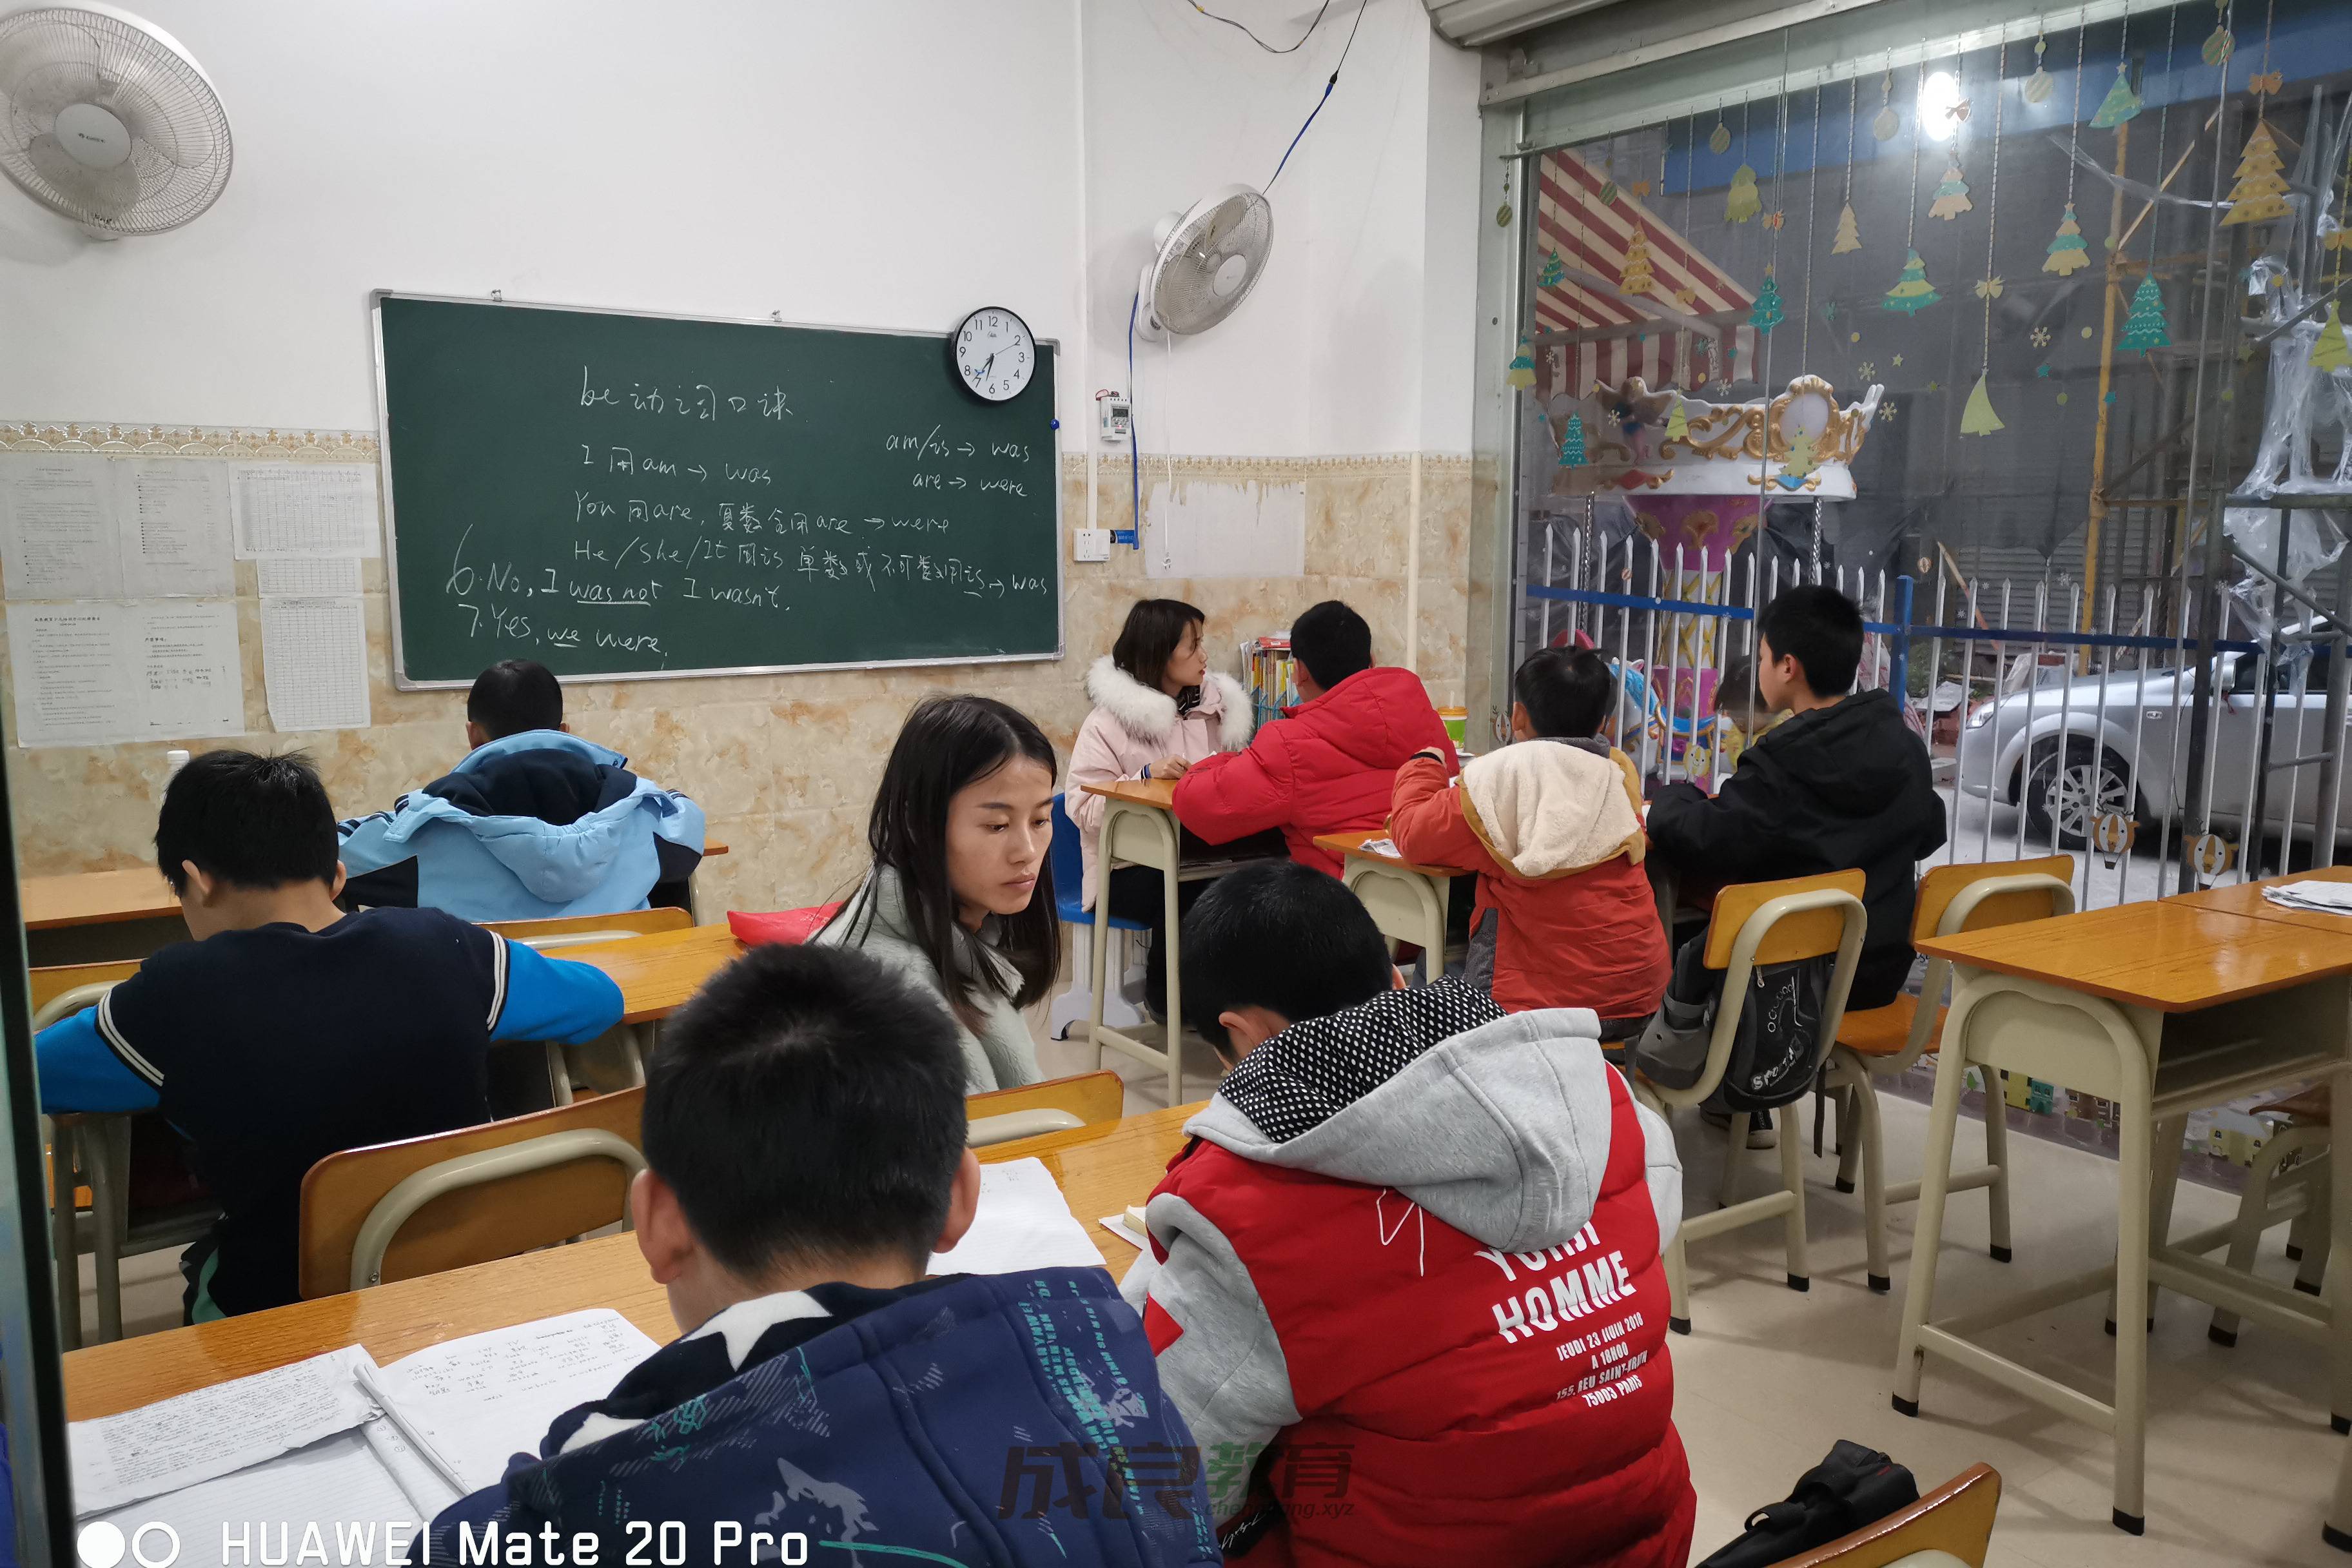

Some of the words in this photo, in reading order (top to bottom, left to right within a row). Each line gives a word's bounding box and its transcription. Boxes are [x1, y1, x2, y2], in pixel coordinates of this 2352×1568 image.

[974, 319, 983, 330] 11
[988, 316, 998, 327] 12
[963, 331, 972, 342] 10
[1014, 335, 1021, 346] 2
[959, 346, 966, 358] 9
[1018, 352, 1024, 362] 3
[965, 365, 970, 376] 8
[1013, 369, 1019, 379] 4
[989, 384, 995, 394] 6
[1003, 380, 1010, 391] 5
[992, 443, 1030, 462] was
[582, 444, 593, 464] I
[725, 463, 771, 485] was
[913, 473, 941, 489] are
[981, 478, 1028, 496] were
[575, 491, 616, 522] You
[892, 515, 950, 534] were
[541, 568, 560, 593] I
[569, 581, 612, 602] was
[623, 580, 663, 600] not
[683, 578, 701, 598] I
[1012, 574, 1047, 595] was
[548, 627, 580, 642] we
[1492, 1250, 1638, 1344] HOMME
[1556, 1338, 1587, 1362] JEUDI
[1586, 1332, 1602, 1349] 23
[1624, 1311, 1643, 1332] 2018
[1591, 1355, 1599, 1369] A
[1600, 1341, 1629, 1366] 18H00
[1582, 1386, 1618, 1407] 75003
[1615, 1375, 1643, 1396] PARIS
